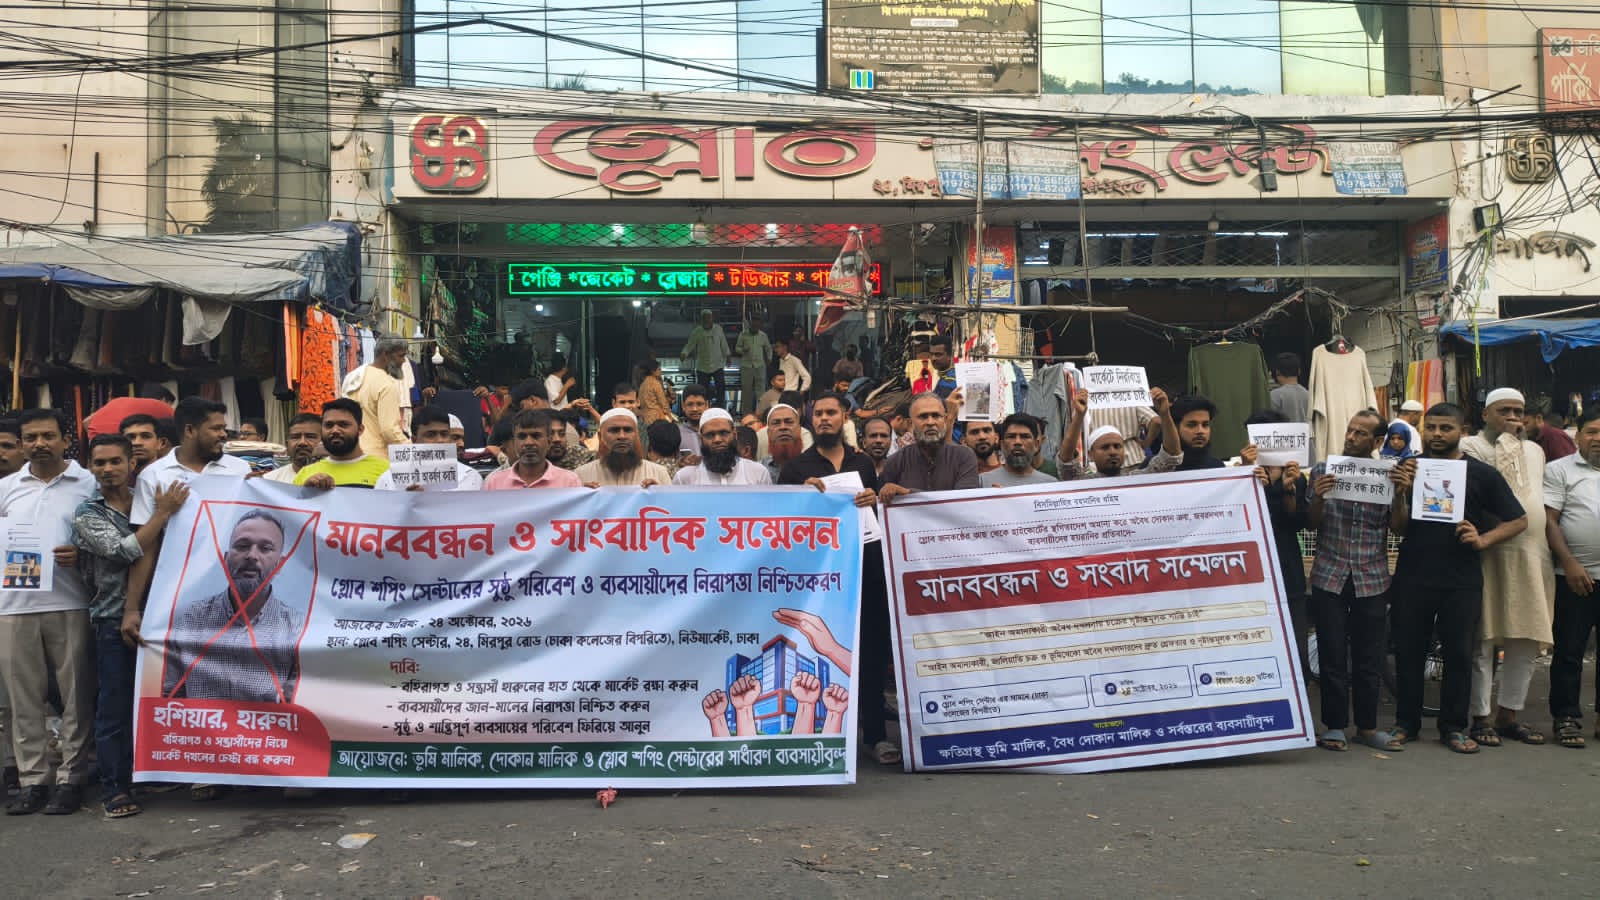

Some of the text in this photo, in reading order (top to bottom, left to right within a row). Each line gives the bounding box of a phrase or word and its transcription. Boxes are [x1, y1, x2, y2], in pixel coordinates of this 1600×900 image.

[325, 506, 841, 560] মানববন্ধন ও সাংবাদিক সম্মেলন
[371, 576, 406, 602] শপিং
[411, 576, 483, 602] সেন্টারের
[517, 570, 576, 598] পরিবেশ
[582, 575, 594, 595] ও
[600, 567, 688, 596] ব্যবসায়ীদের
[693, 568, 753, 594] নিরাপত্তা
[758, 566, 841, 594] নিশ্চিতকরণ
[916, 549, 1248, 604] মানববন্ধন ও সংবাদ সম্মেলন
[500, 617, 533, 629] ২০২৬
[381, 634, 408, 650] শপিং
[516, 634, 542, 648] রোড
[736, 632, 760, 646] ঢাকা
[454, 681, 463, 694] ও
[571, 679, 601, 693] থেকে
[605, 676, 639, 693] মার্কেট
[643, 679, 664, 693] রক্ষা
[668, 679, 699, 693] করুন
[532, 698, 575, 714] নিরাপত্তা
[578, 697, 615, 713] নিশ্চিত
[619, 699, 650, 714] করুন
[415, 722, 425, 734] ও
[532, 719, 574, 735] পরিবেশ
[619, 720, 650, 736] আনুন
[488, 750, 534, 772] দোকান
[537, 745, 579, 769] মালিক
[583, 751, 594, 768] ও
[632, 745, 665, 768] শপিং
[667, 748, 725, 772] সেন্টারের
